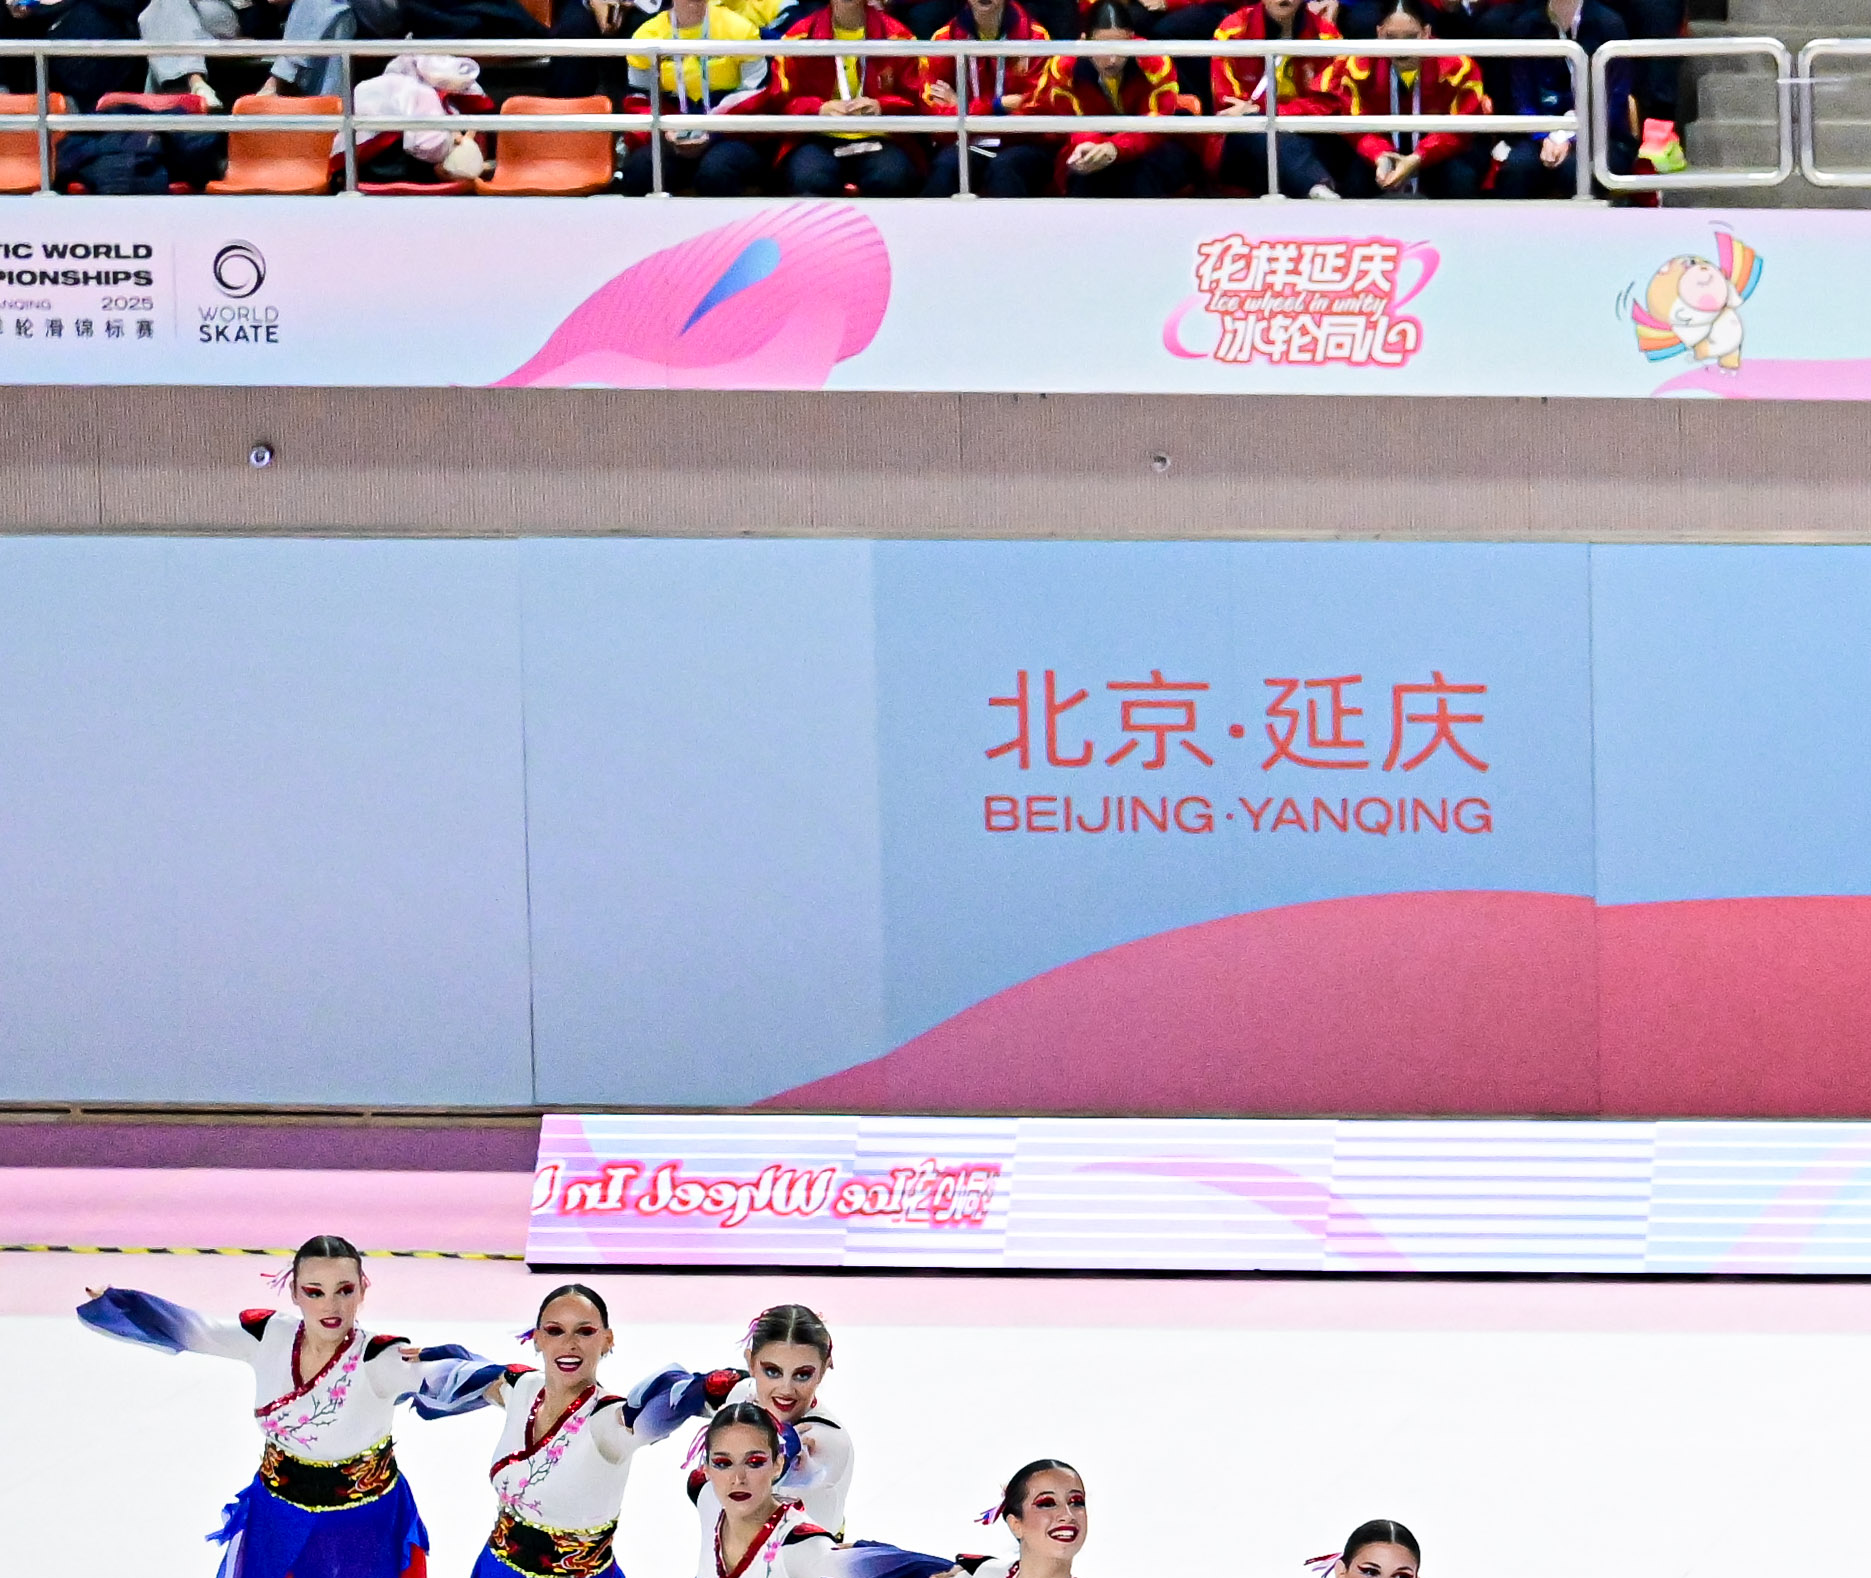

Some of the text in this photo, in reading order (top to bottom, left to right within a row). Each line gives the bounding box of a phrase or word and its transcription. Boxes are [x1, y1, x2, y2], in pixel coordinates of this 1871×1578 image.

[42, 243, 153, 259] WORLD
[1197, 234, 1398, 293] 花样延庆
[101, 296, 154, 311] 2025
[198, 305, 280, 324] WORLD
[0, 318, 154, 338] 轮滑锦标赛
[199, 325, 280, 344] SKATE
[1214, 314, 1418, 364] 冰轮同心
[984, 669, 1490, 773] 北京·延庆
